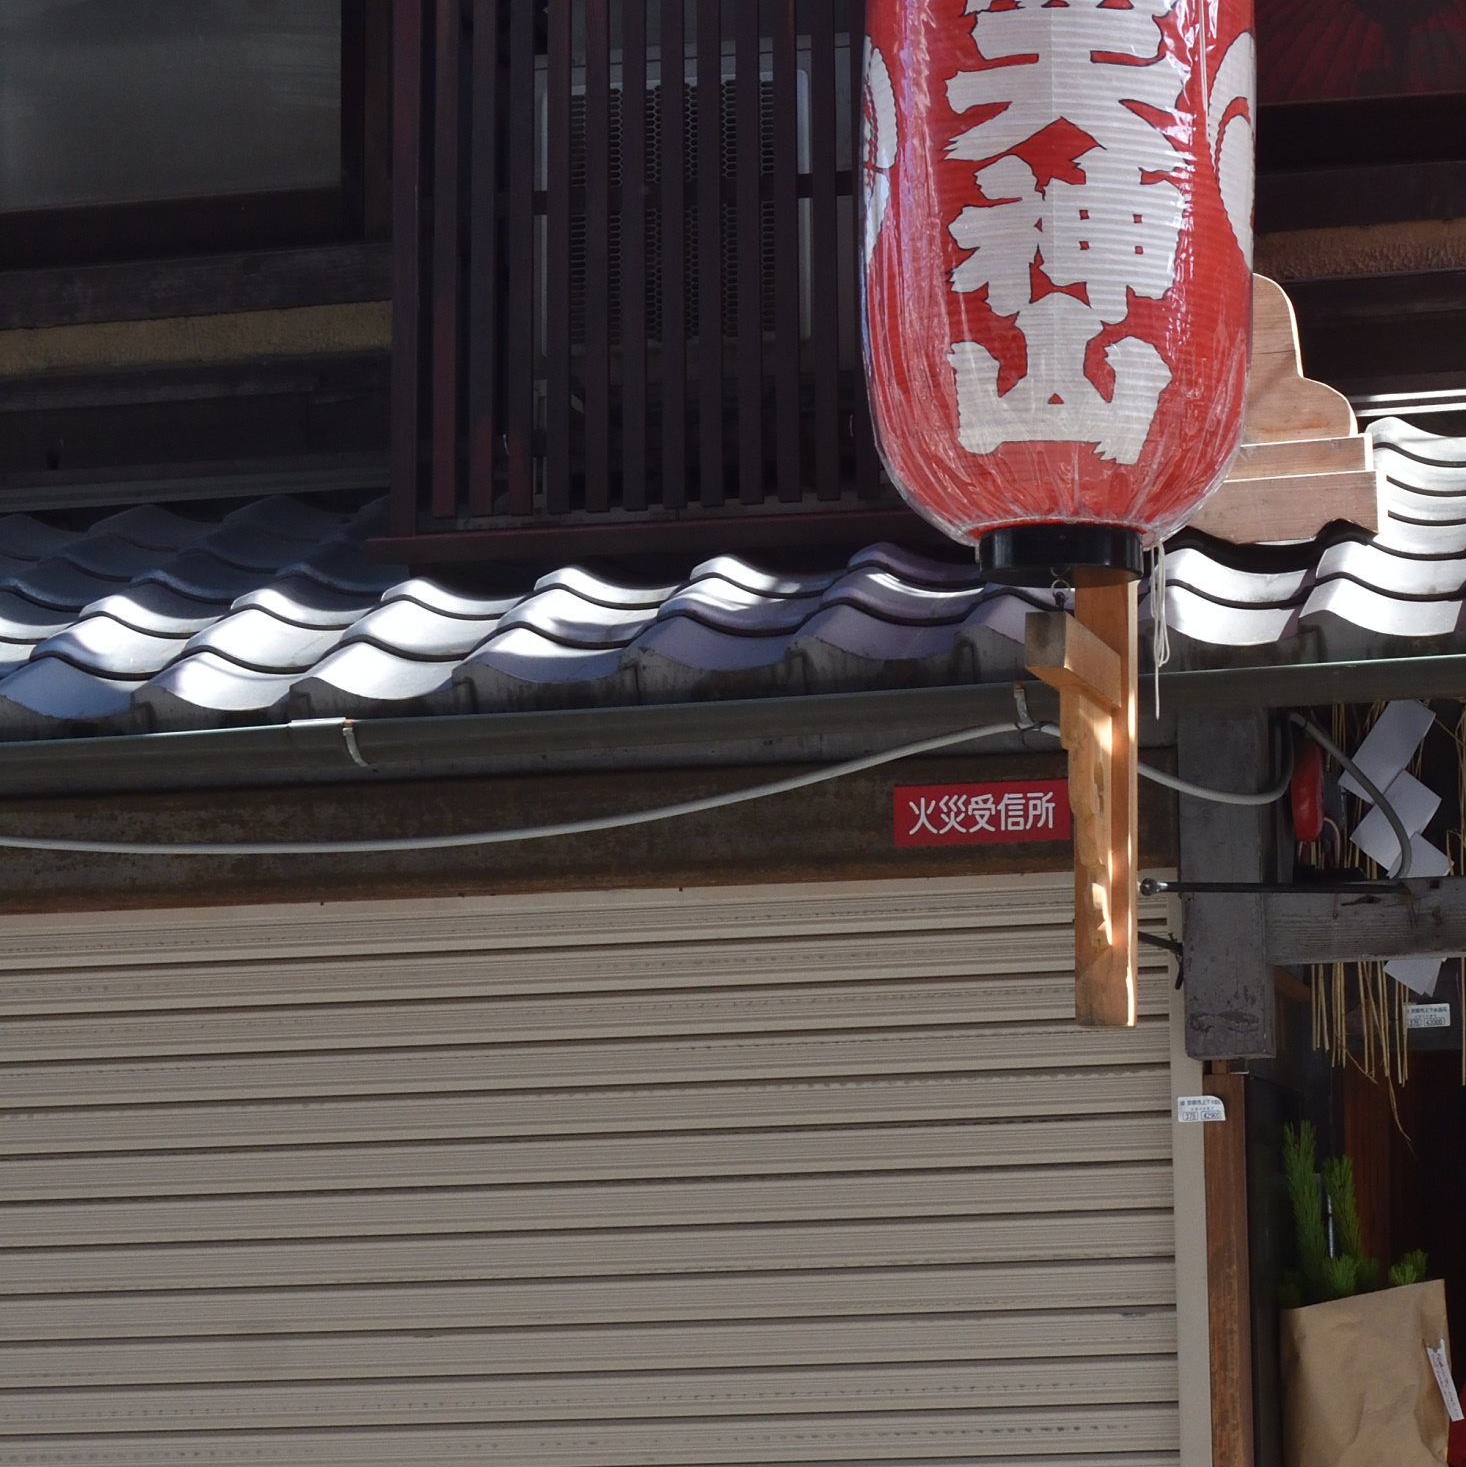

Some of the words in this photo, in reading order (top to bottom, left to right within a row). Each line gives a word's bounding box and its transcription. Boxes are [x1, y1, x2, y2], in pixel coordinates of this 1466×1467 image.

[908, 791, 1056, 835] 火災受信所
